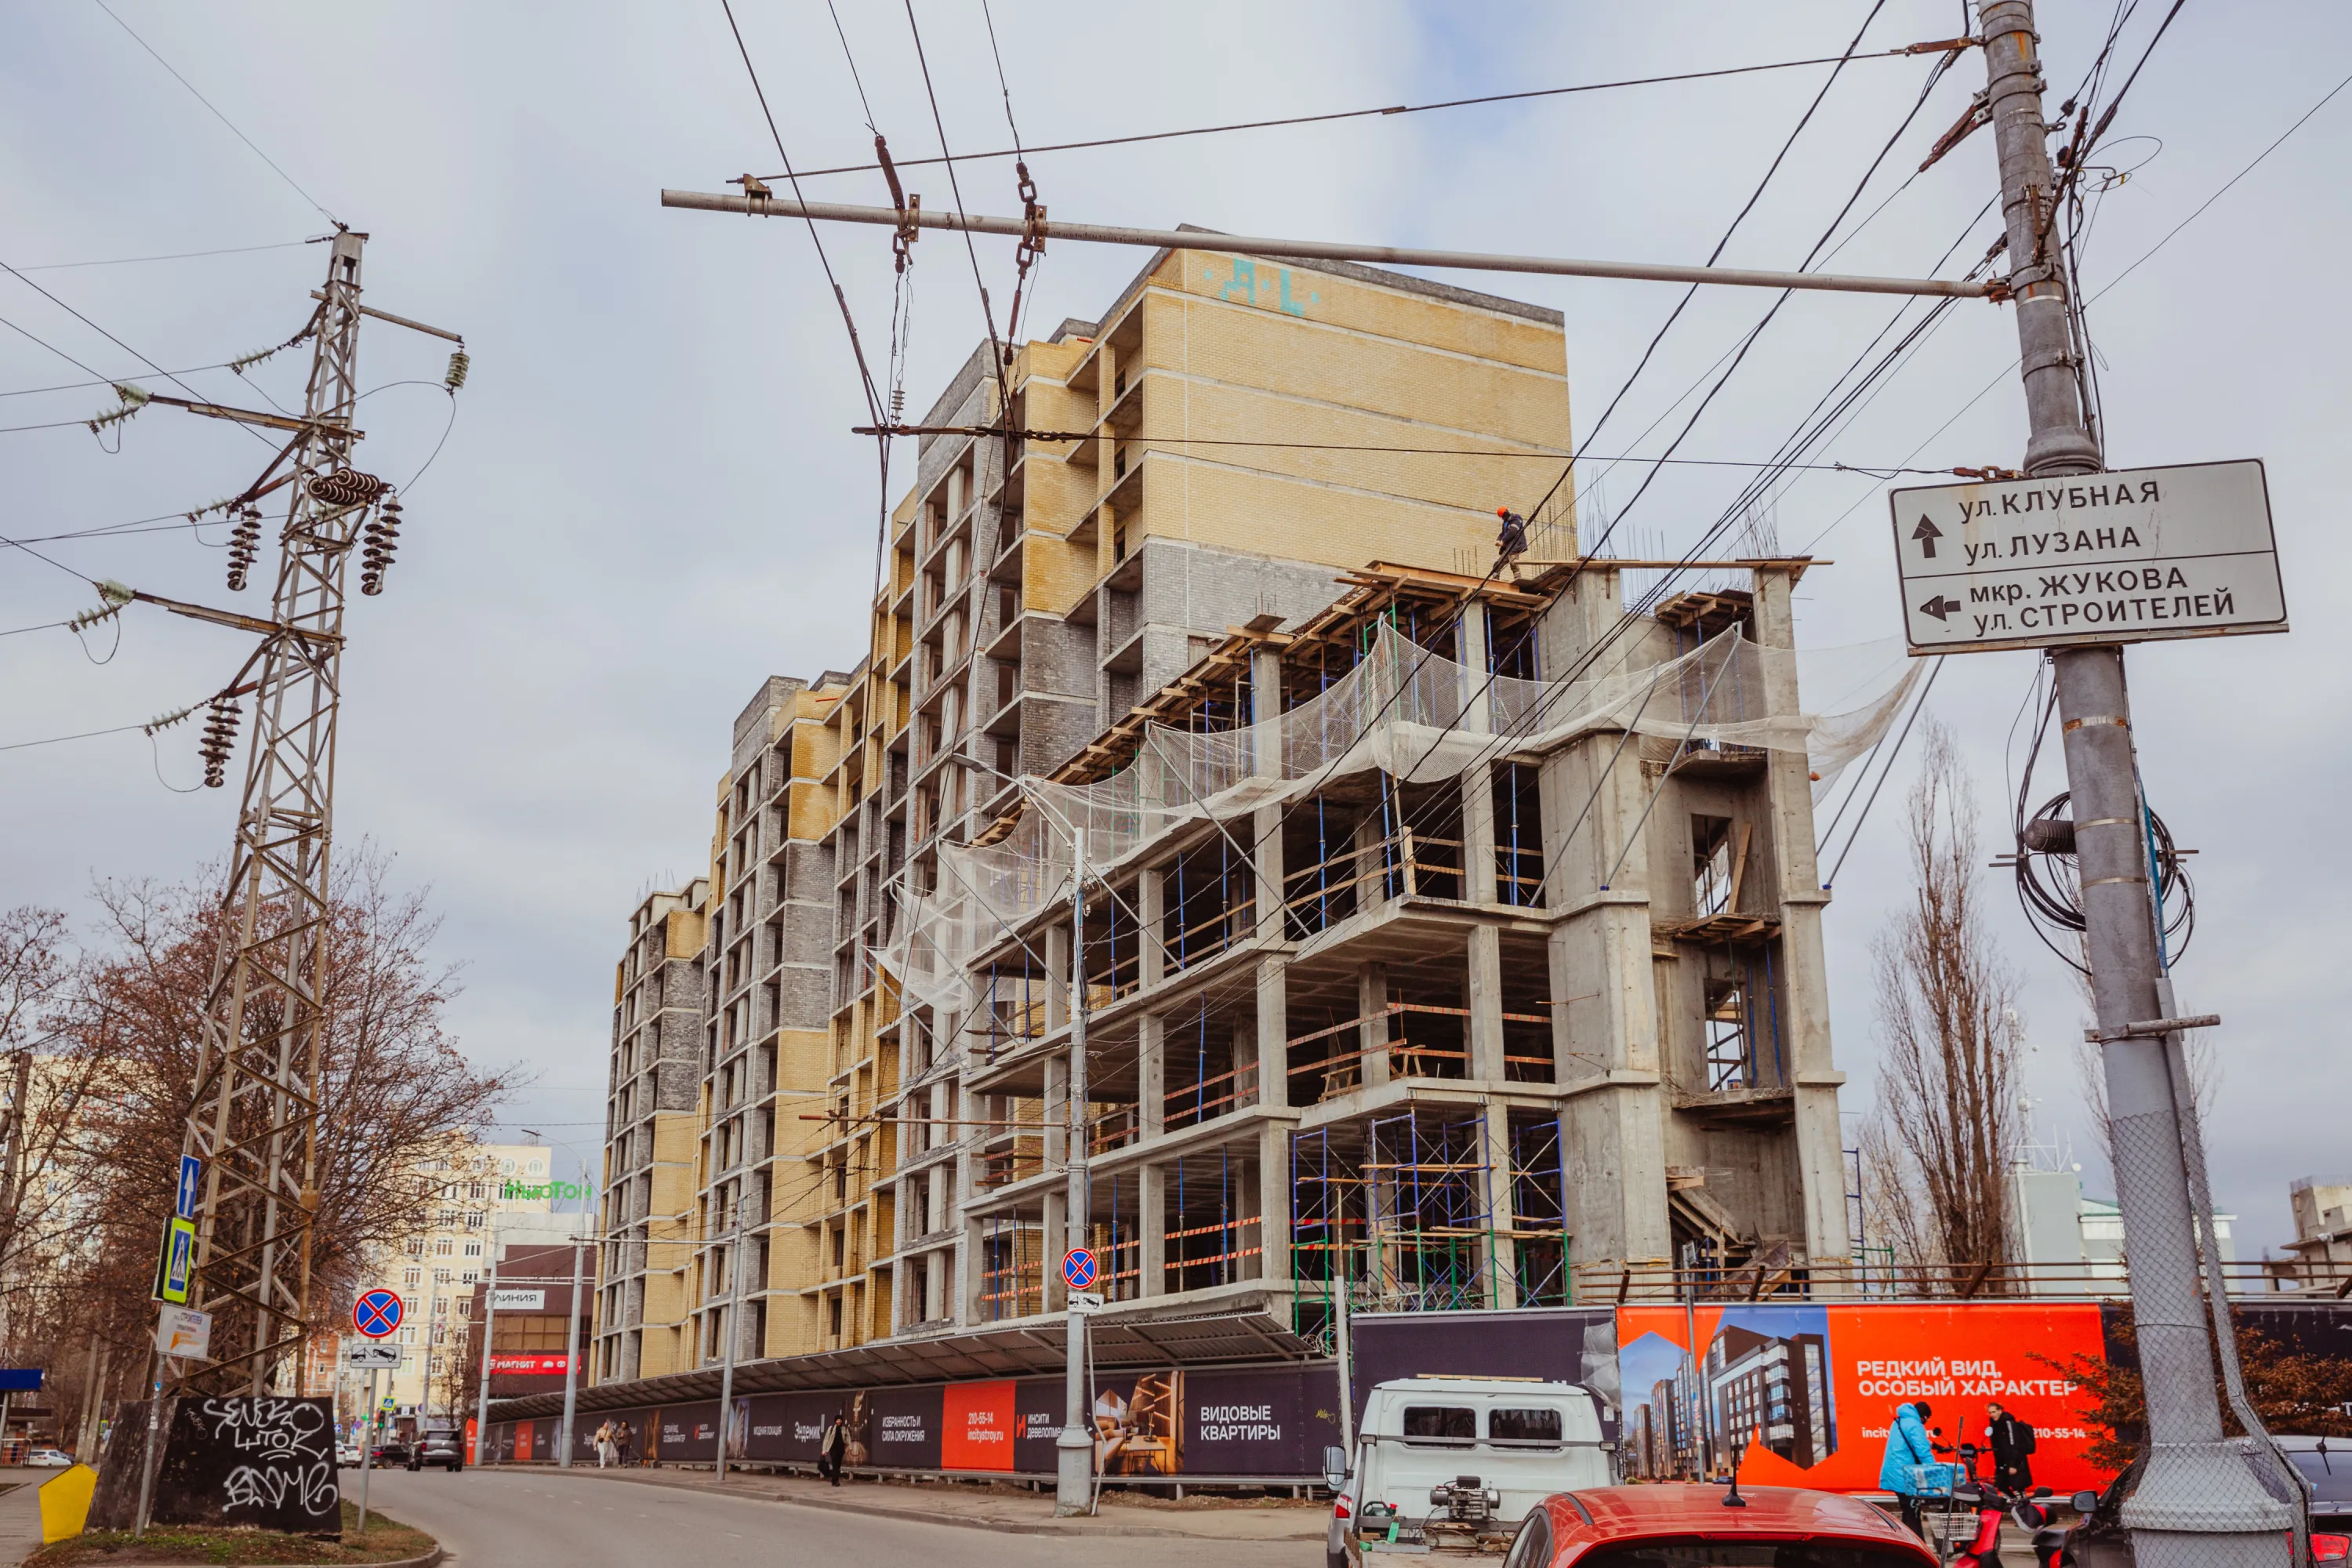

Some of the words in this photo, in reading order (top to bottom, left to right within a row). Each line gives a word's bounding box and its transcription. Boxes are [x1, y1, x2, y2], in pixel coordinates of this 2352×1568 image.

[1958, 500, 1997, 523] ул.
[2002, 481, 2160, 515] КЛУБНАЯ
[1965, 543, 2002, 566] ул.
[2010, 526, 2141, 557] ЛУЗАНА
[1969, 583, 2031, 606] мкр.
[2038, 567, 2188, 598] ЖУКОВА
[1973, 614, 2013, 637] ул.
[2019, 586, 2234, 628] СТРОИТЕЛЕЙ
[497, 1360, 535, 1370] МАГНИТ
[1857, 1357, 1947, 1379] РЕДКИЙ
[1952, 1360, 2002, 1379] ВИД,
[1859, 1377, 1955, 1396] ОСОБЫЙ
[1961, 1380, 2078, 1396] ХАРАКТЕР
[882, 1416, 916, 1427] ИЗБРАННОСТЬ
[916, 1416, 921, 1427] И
[967, 1412, 993, 1425] 210-55-14
[1200, 1405, 1272, 1424] ВИДОВЫЕ
[882, 1430, 895, 1442] СИЛА
[895, 1430, 925, 1442] ОКРУЖЕНИЯ
[1200, 1425, 1281, 1441] КВАРТИРЫ
